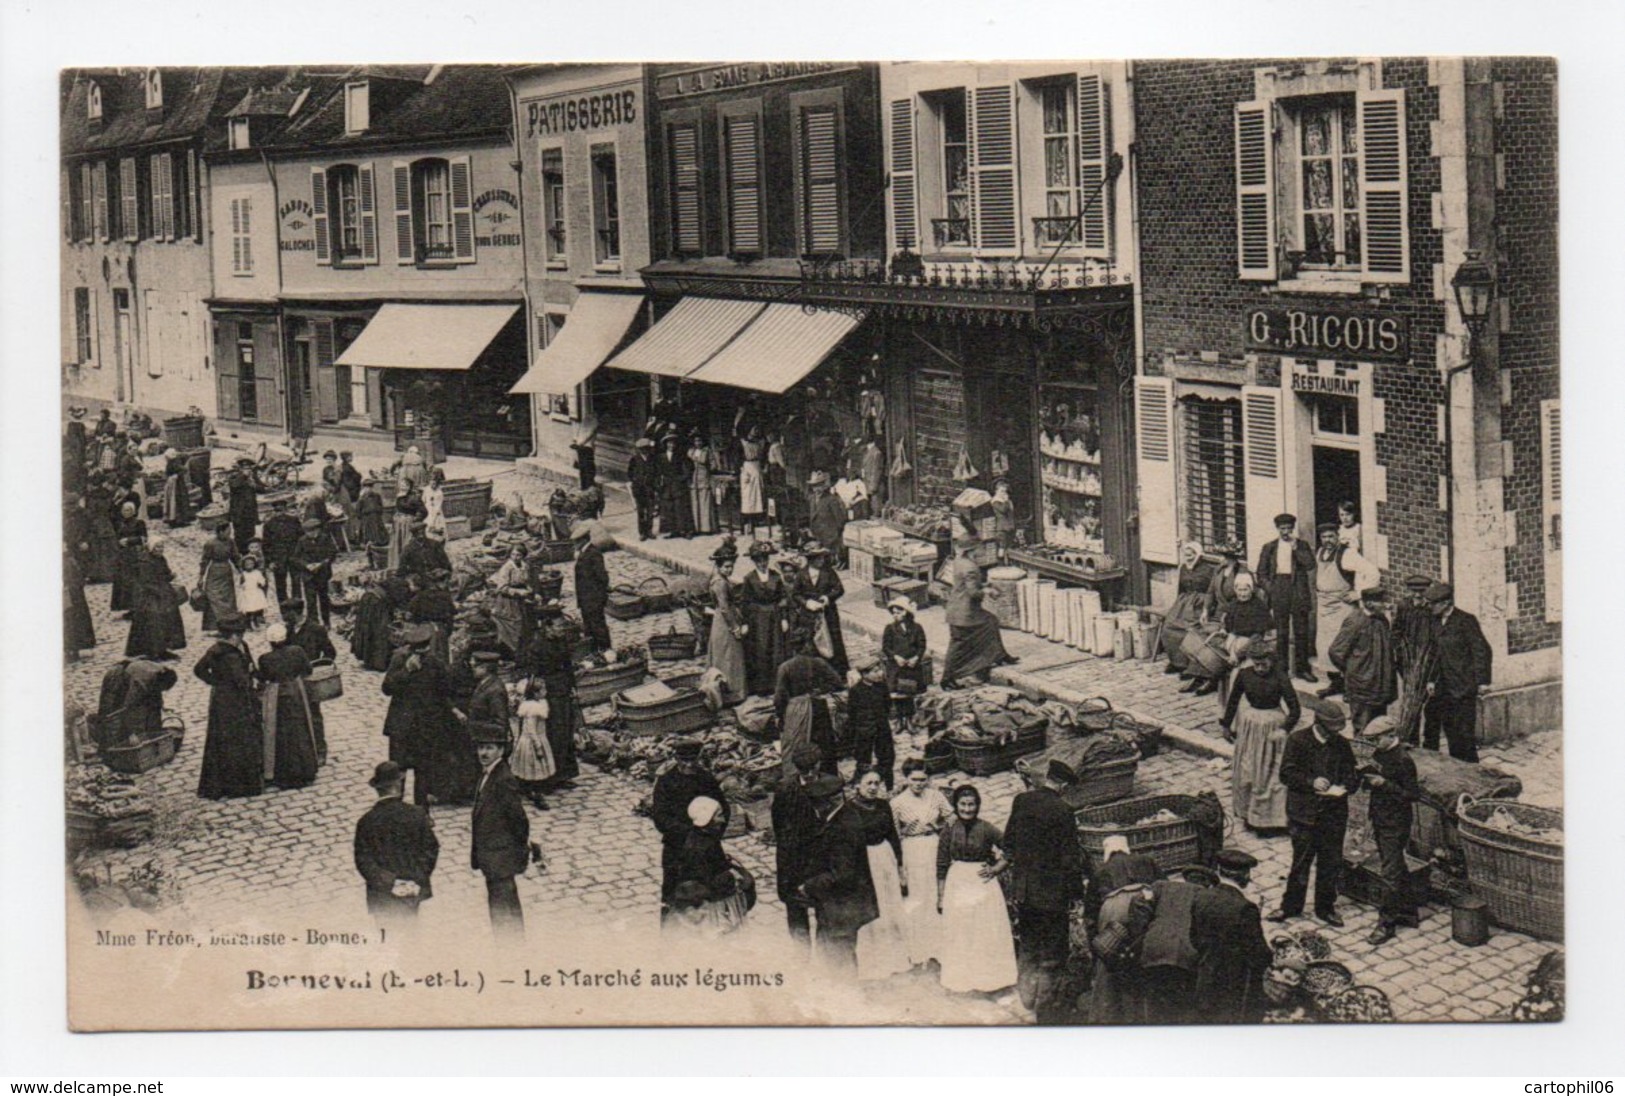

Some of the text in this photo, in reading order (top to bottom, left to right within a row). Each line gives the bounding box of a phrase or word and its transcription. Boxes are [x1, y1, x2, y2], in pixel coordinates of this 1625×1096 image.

[528, 89, 636, 138] PATISSERIE
[1250, 309, 1398, 352] G. RICOIS
[1292, 372, 1360, 394] RESTAURANT
